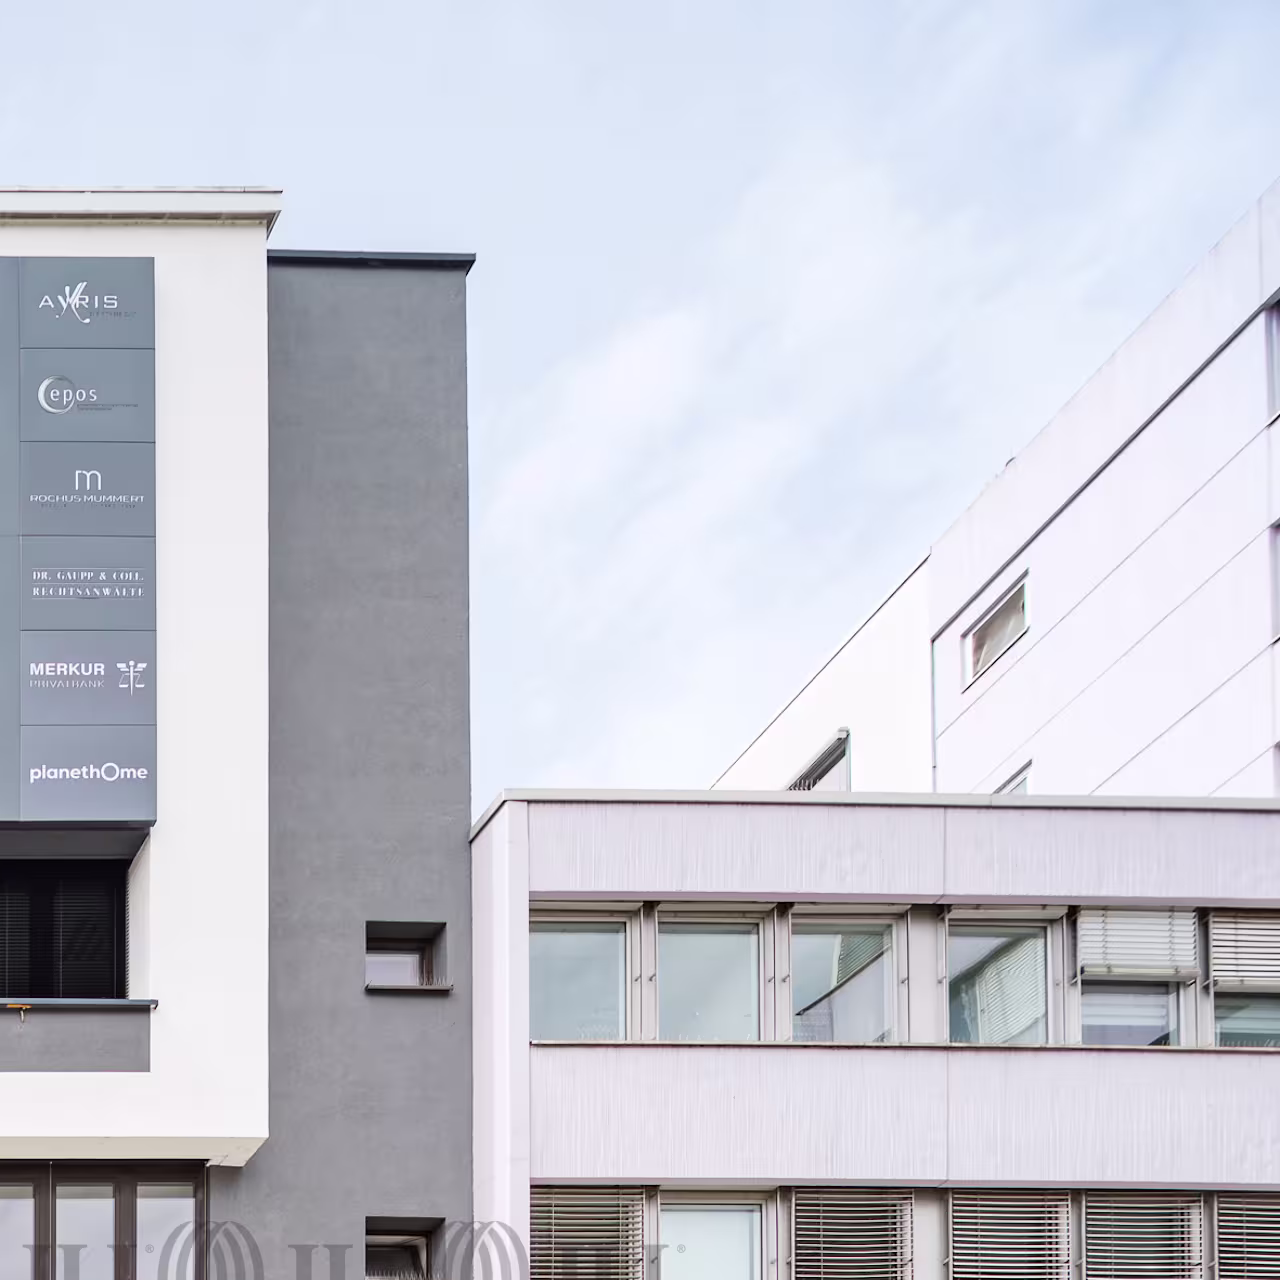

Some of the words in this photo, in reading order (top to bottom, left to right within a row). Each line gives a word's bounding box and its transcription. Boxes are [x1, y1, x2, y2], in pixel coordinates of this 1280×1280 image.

[30, 494, 81, 503] ROCHUS
[83, 494, 145, 503] MUMMERT
[57, 571, 94, 581] GAUPP
[29, 662, 105, 676] MERKUR
[29, 679, 105, 688] PRIVATBANK
